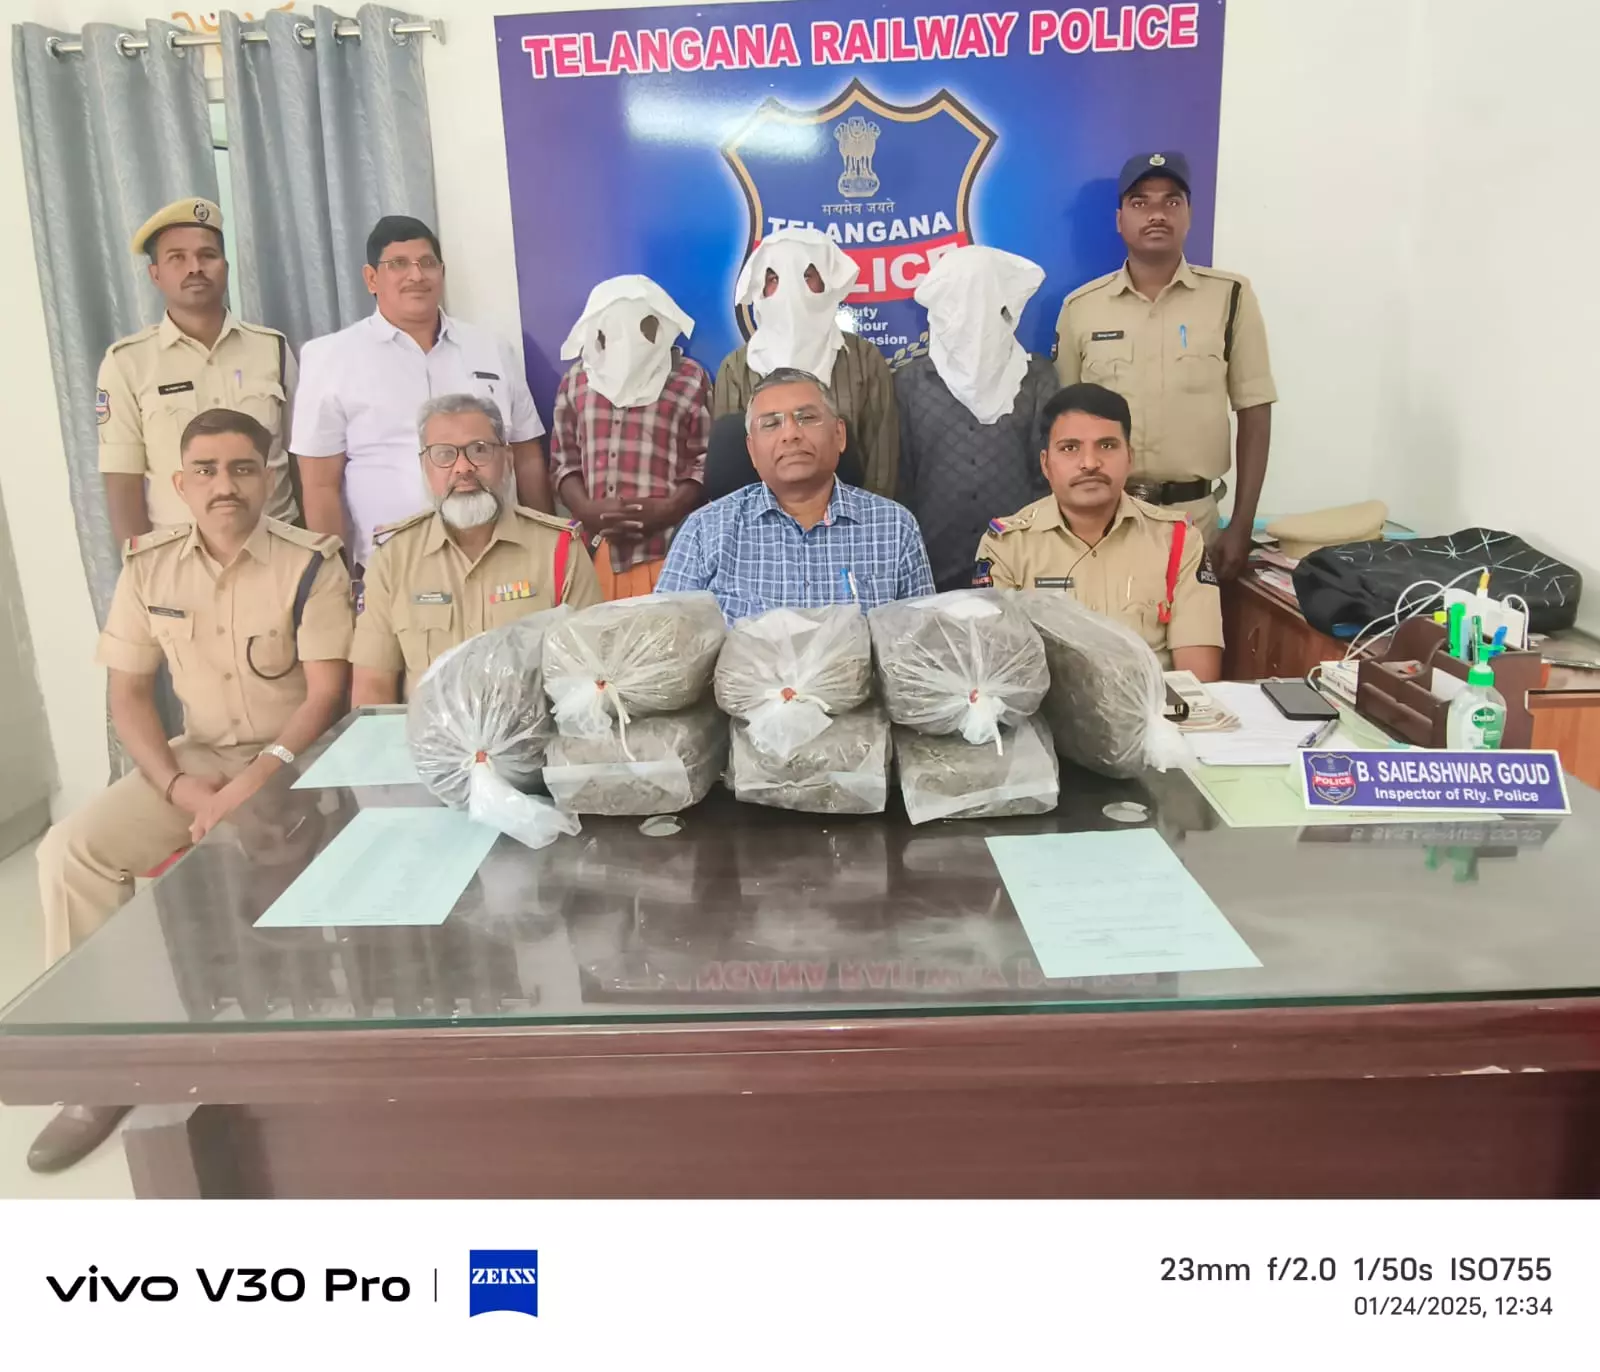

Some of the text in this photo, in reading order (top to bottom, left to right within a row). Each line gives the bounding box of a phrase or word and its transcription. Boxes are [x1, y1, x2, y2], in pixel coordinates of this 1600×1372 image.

[522, 3, 1199, 79] TELANGANA RAILWAY POLICE
[1356, 760, 1550, 785] B. SAIEASHWAR GOUD
[1375, 787, 1539, 804] Inspector of Rly. Police
